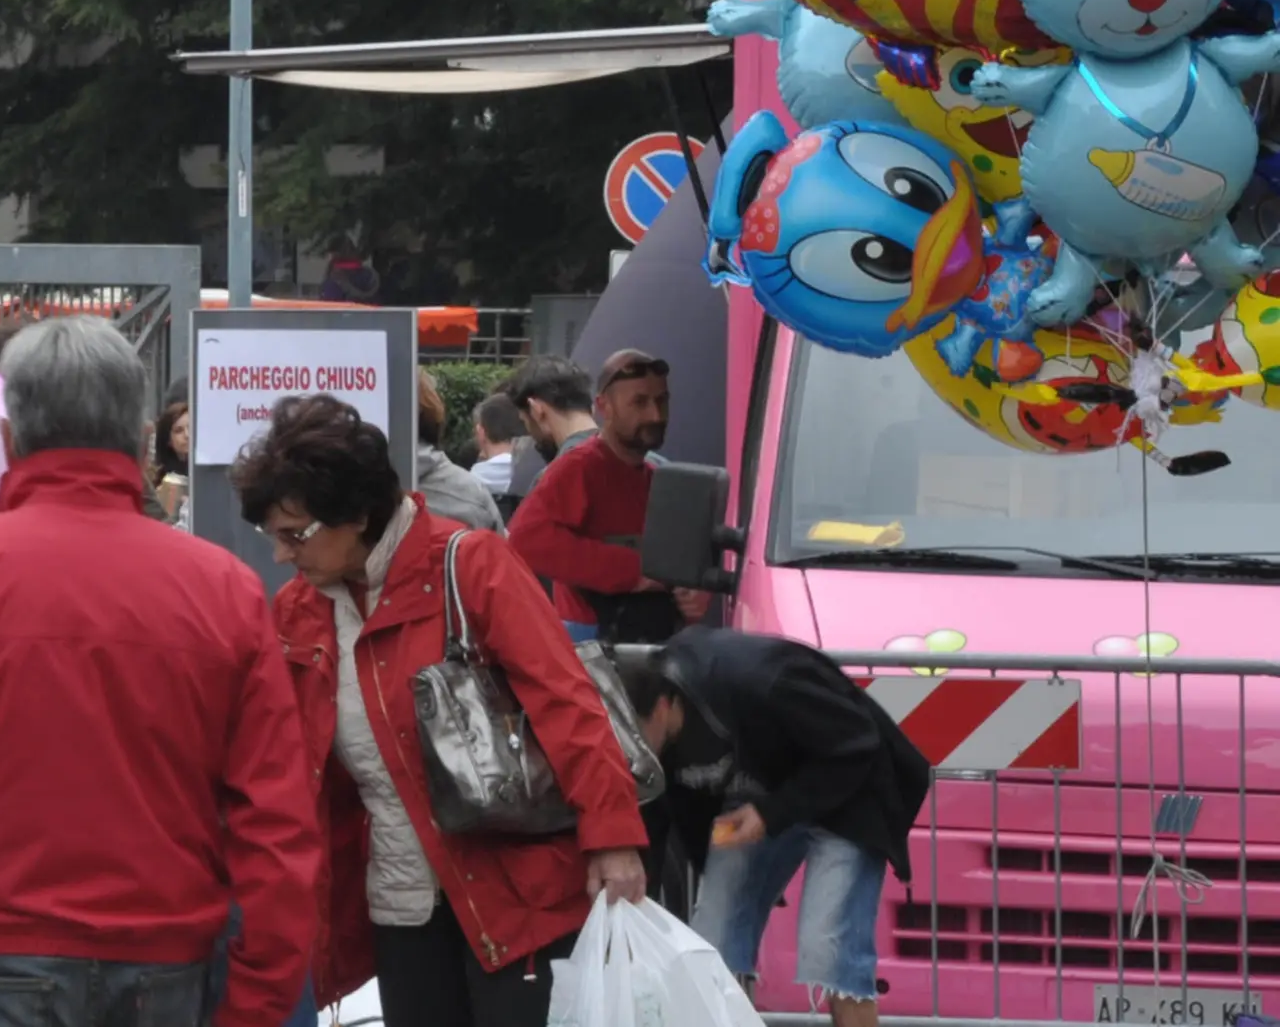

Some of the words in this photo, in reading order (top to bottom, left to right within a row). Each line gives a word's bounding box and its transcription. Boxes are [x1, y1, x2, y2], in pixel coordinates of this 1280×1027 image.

[209, 365, 310, 390] PARCHEGGIO
[316, 366, 377, 391] CHIUSO
[1098, 997, 1131, 1022] AP
